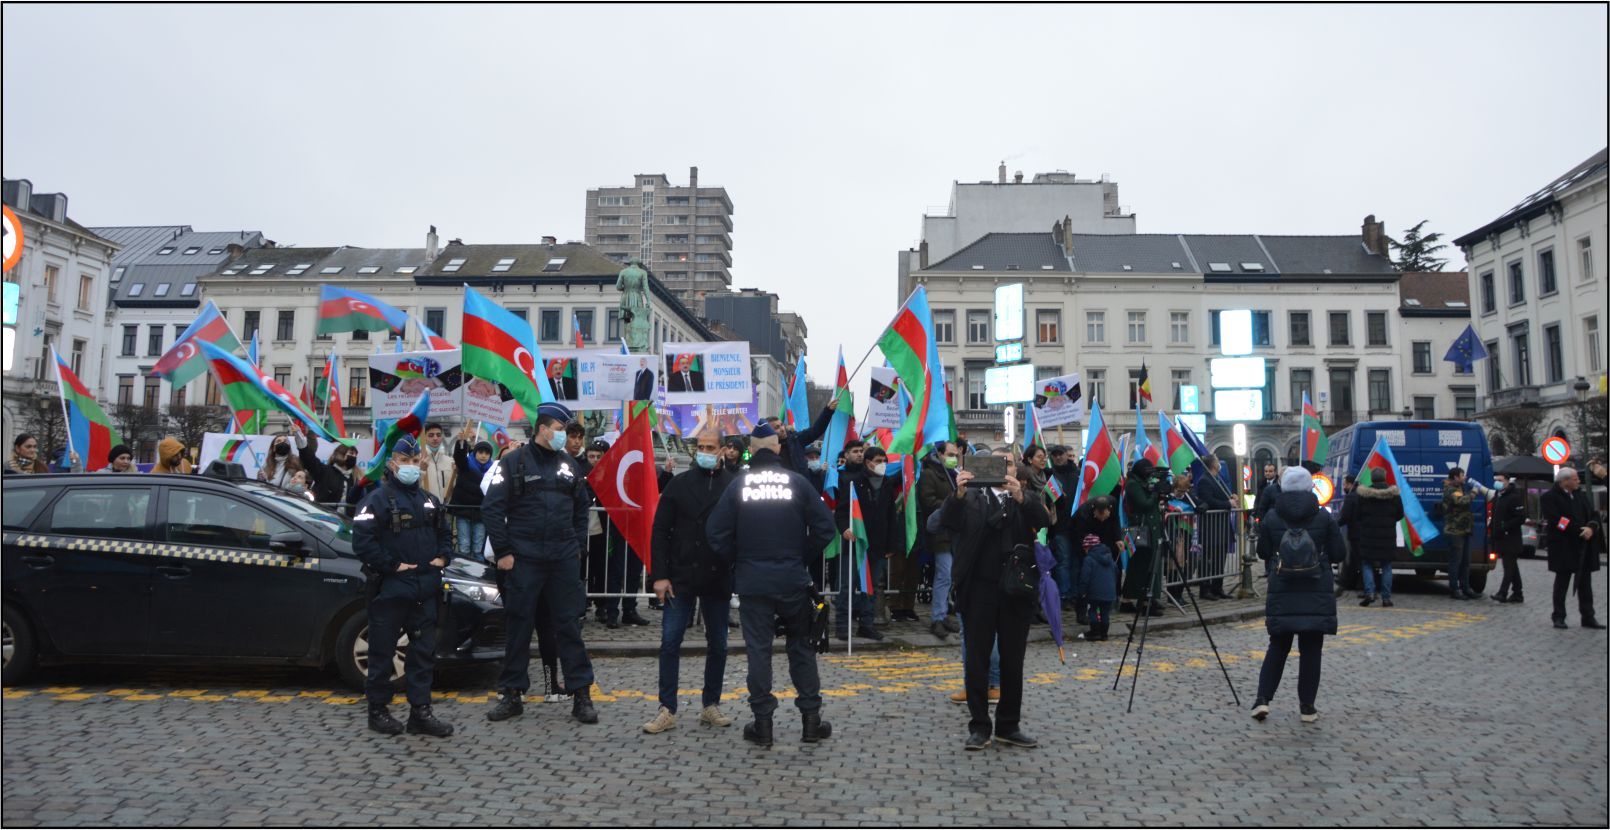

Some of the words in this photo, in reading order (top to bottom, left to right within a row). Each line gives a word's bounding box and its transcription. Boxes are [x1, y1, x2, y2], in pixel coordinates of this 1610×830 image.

[707, 381, 714, 390] LE
[745, 471, 789, 485] Police
[743, 485, 792, 501] Politie
